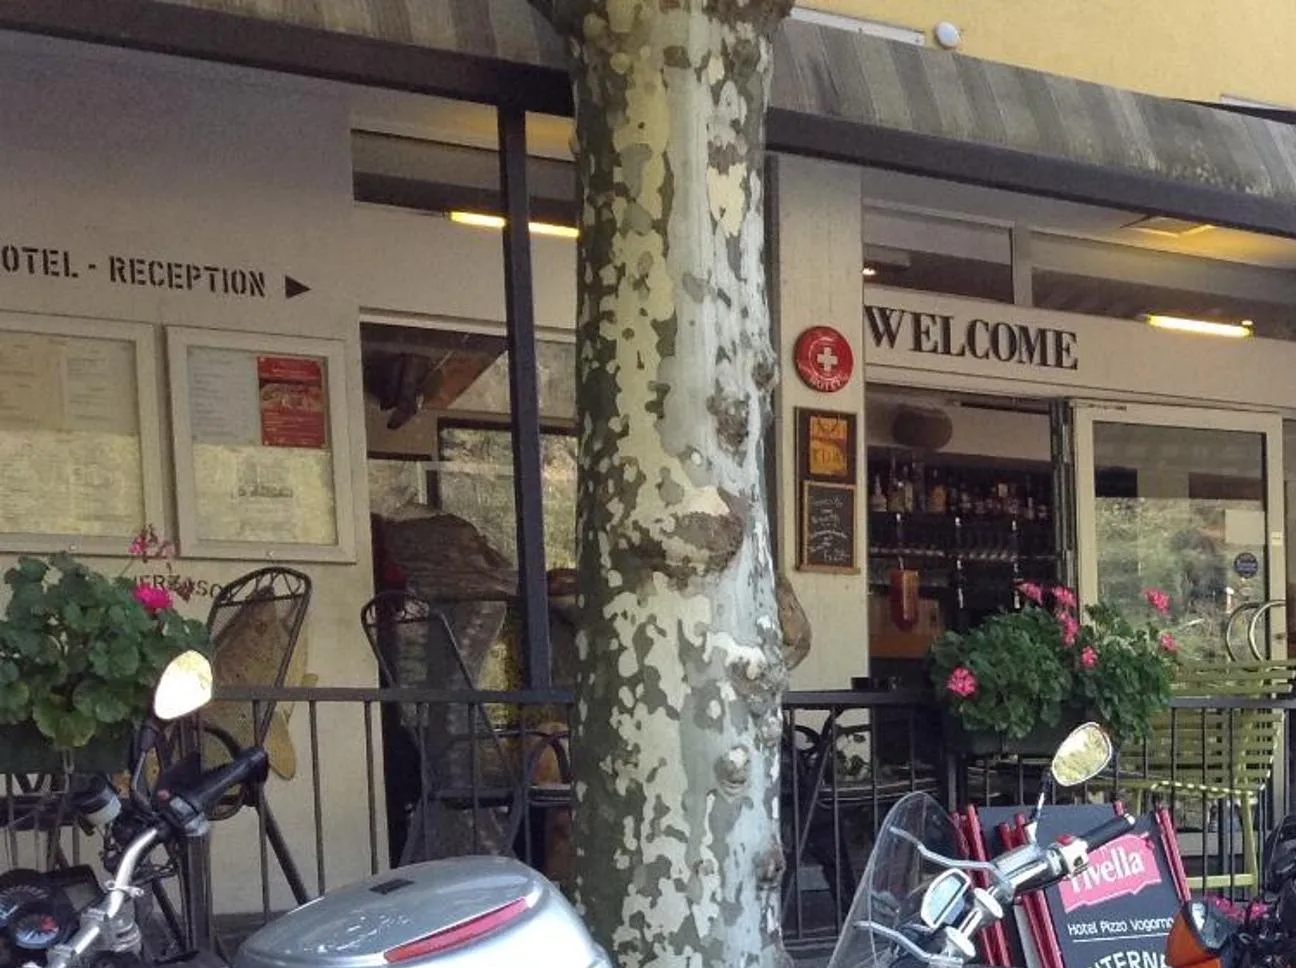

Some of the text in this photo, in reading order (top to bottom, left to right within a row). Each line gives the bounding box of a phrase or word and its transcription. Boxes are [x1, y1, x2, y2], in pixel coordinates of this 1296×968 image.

[109, 255, 265, 297] RECEPTION
[864, 305, 1078, 370] WELCOME
[1068, 923, 1098, 937] Hotel
